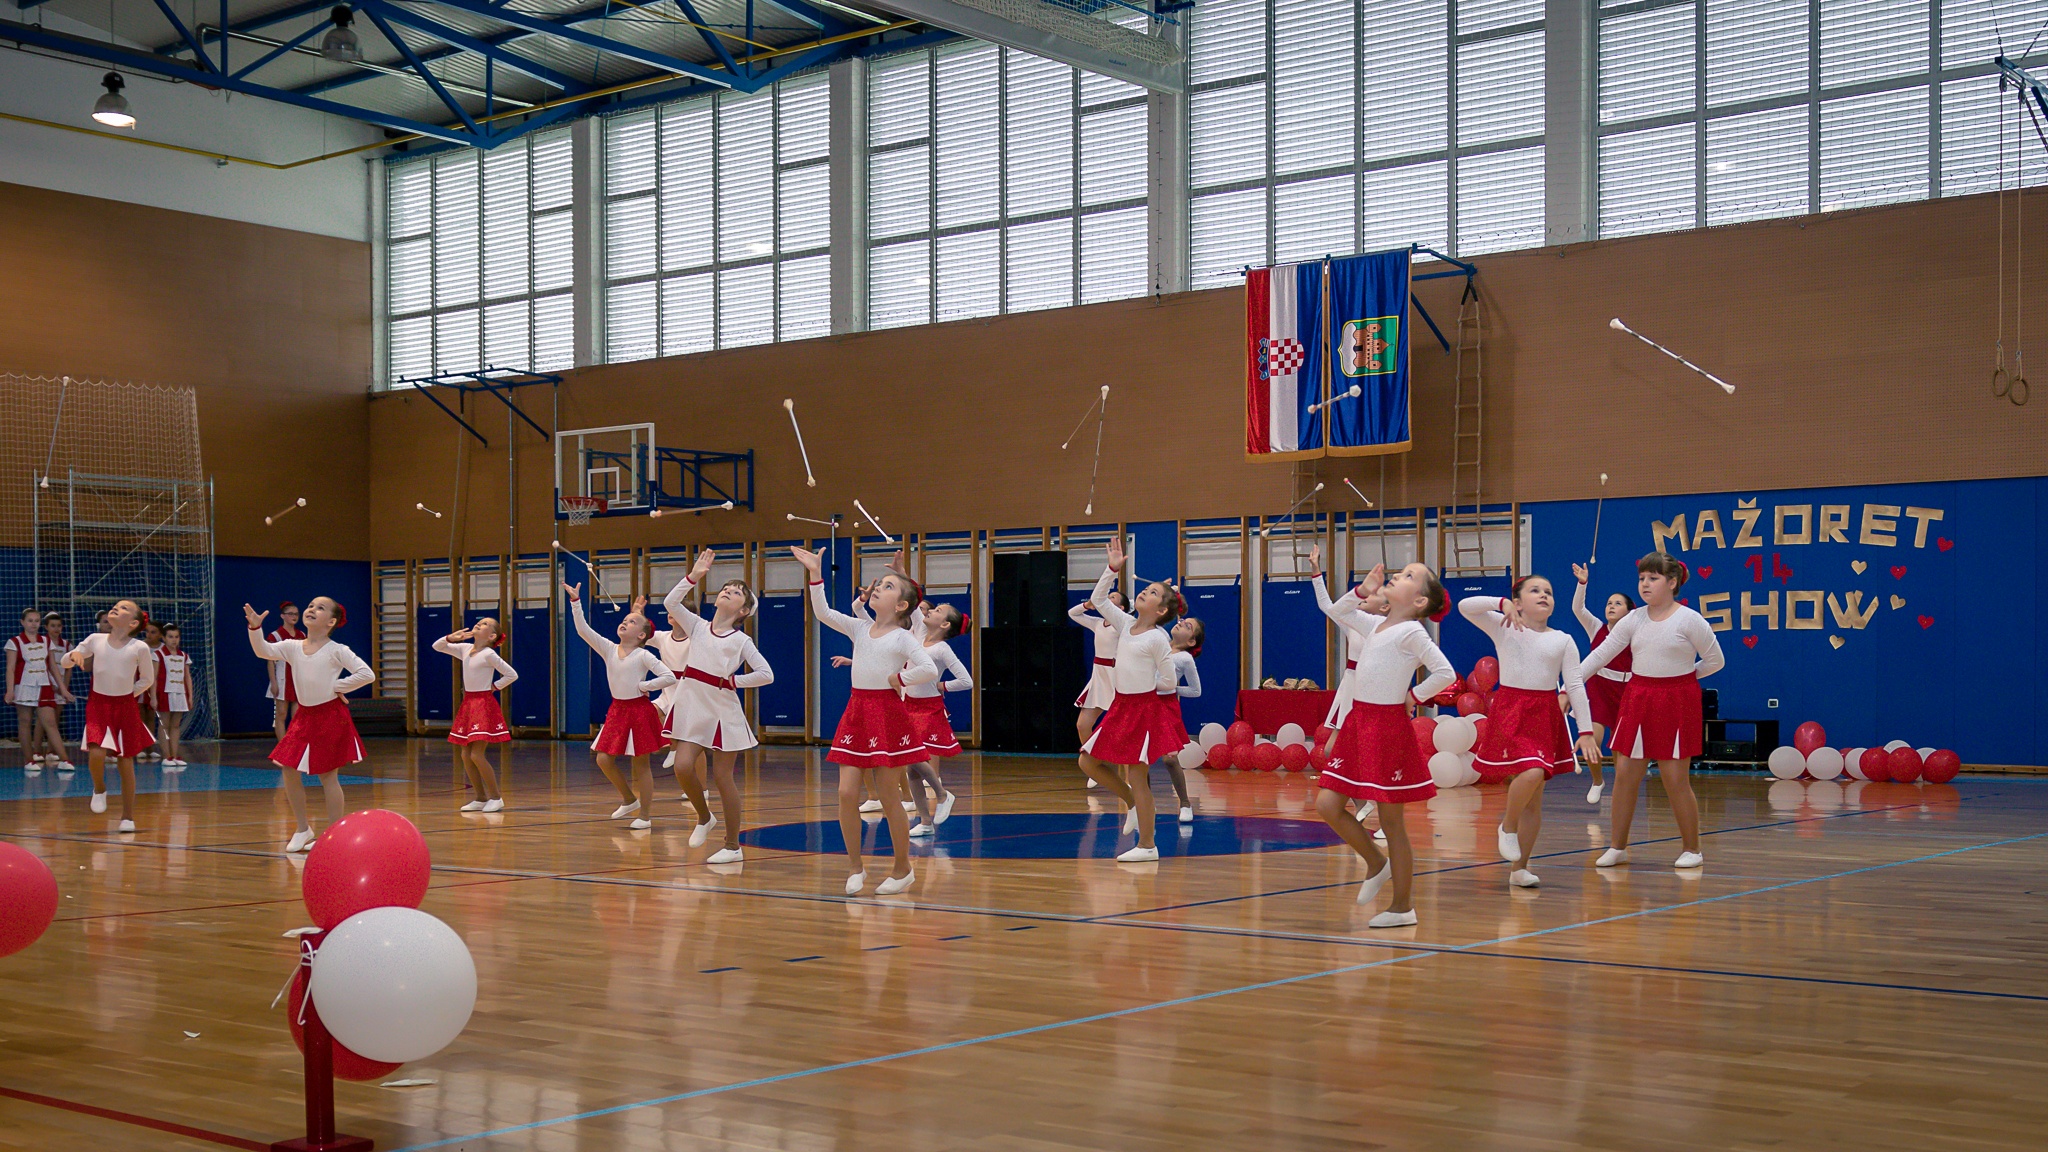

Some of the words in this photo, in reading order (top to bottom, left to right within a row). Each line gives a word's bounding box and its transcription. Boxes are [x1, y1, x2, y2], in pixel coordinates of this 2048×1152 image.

[1651, 497, 1944, 553] MAŽORET
[1744, 552, 1793, 584] 14
[1699, 589, 1879, 632] SHOW
